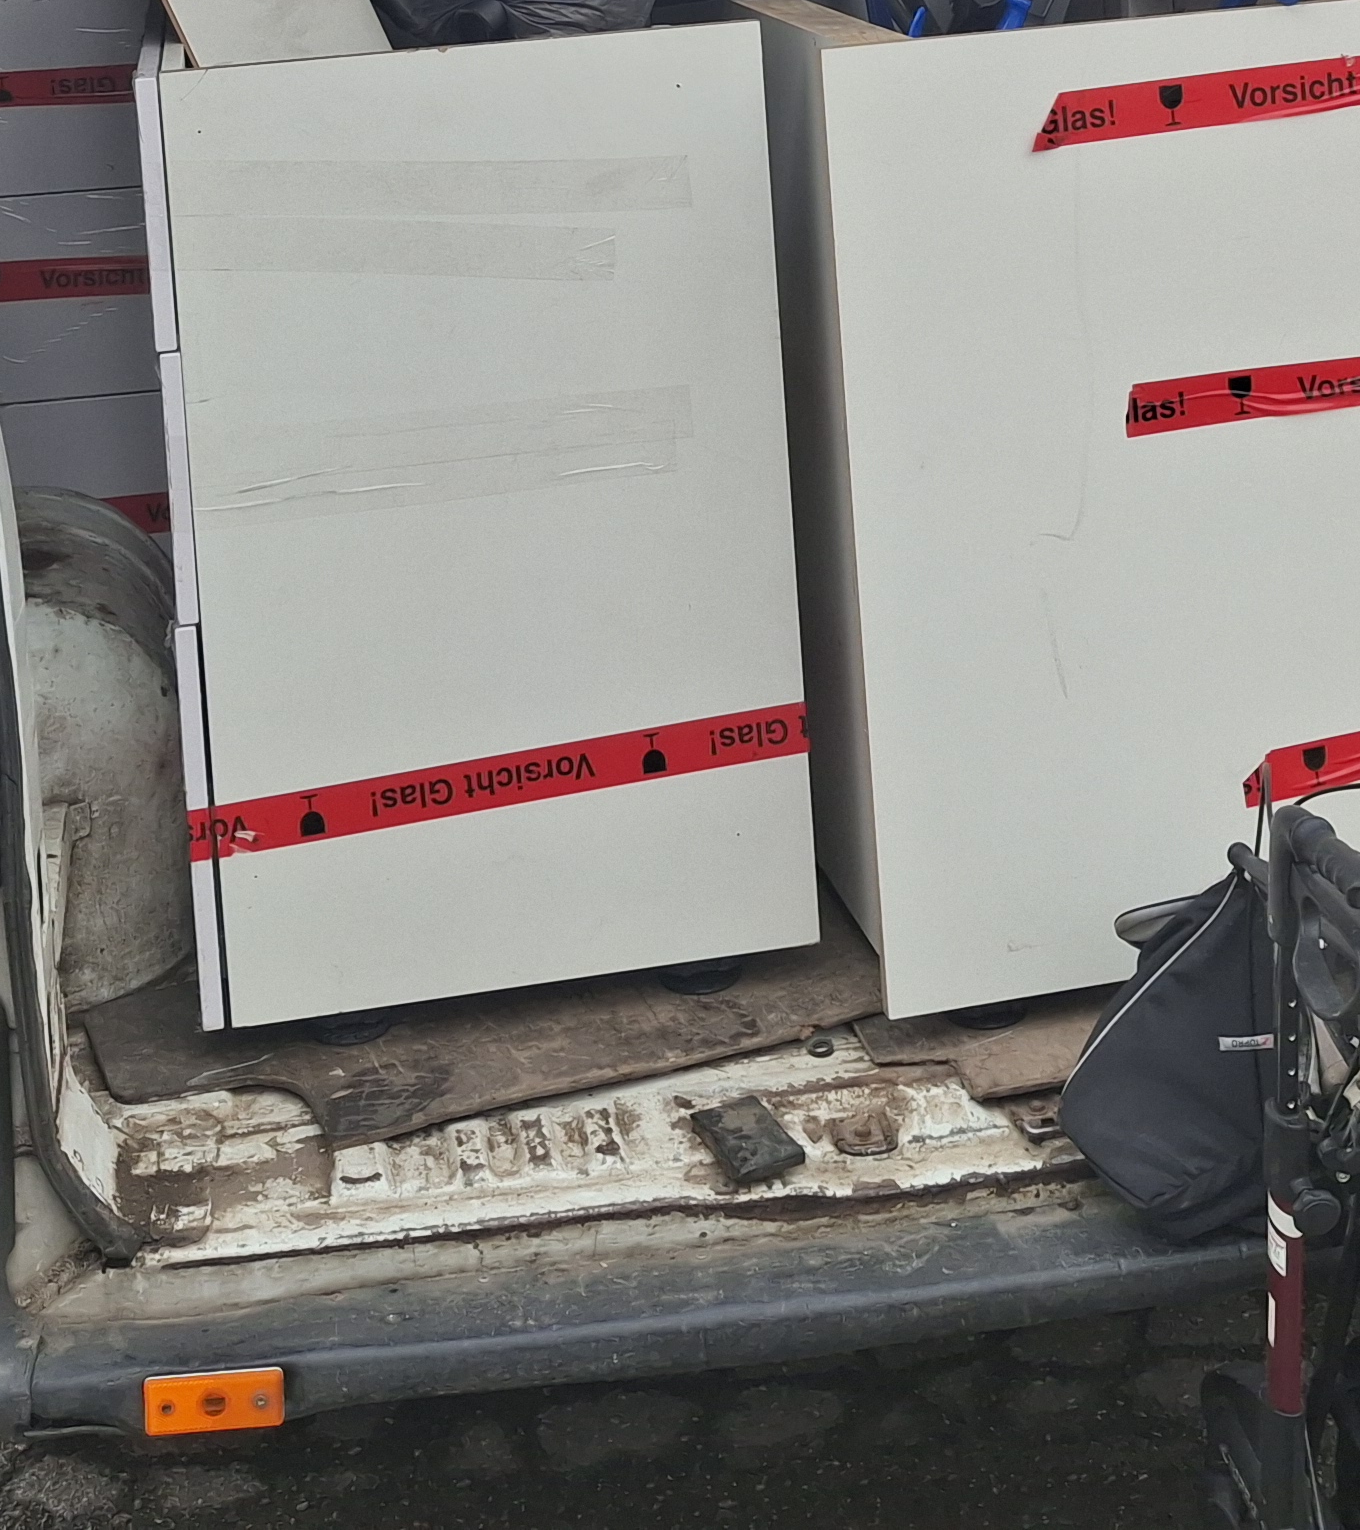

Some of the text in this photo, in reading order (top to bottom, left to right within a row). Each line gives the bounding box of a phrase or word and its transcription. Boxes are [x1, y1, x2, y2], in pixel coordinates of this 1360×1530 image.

[1228, 70, 1358, 109] Vorsicht
[40, 267, 146, 289] Vorsicht
[1126, 391, 1187, 426] las!
[708, 718, 789, 756] Glas!
[370, 752, 597, 817] Vorsicht Glas!
